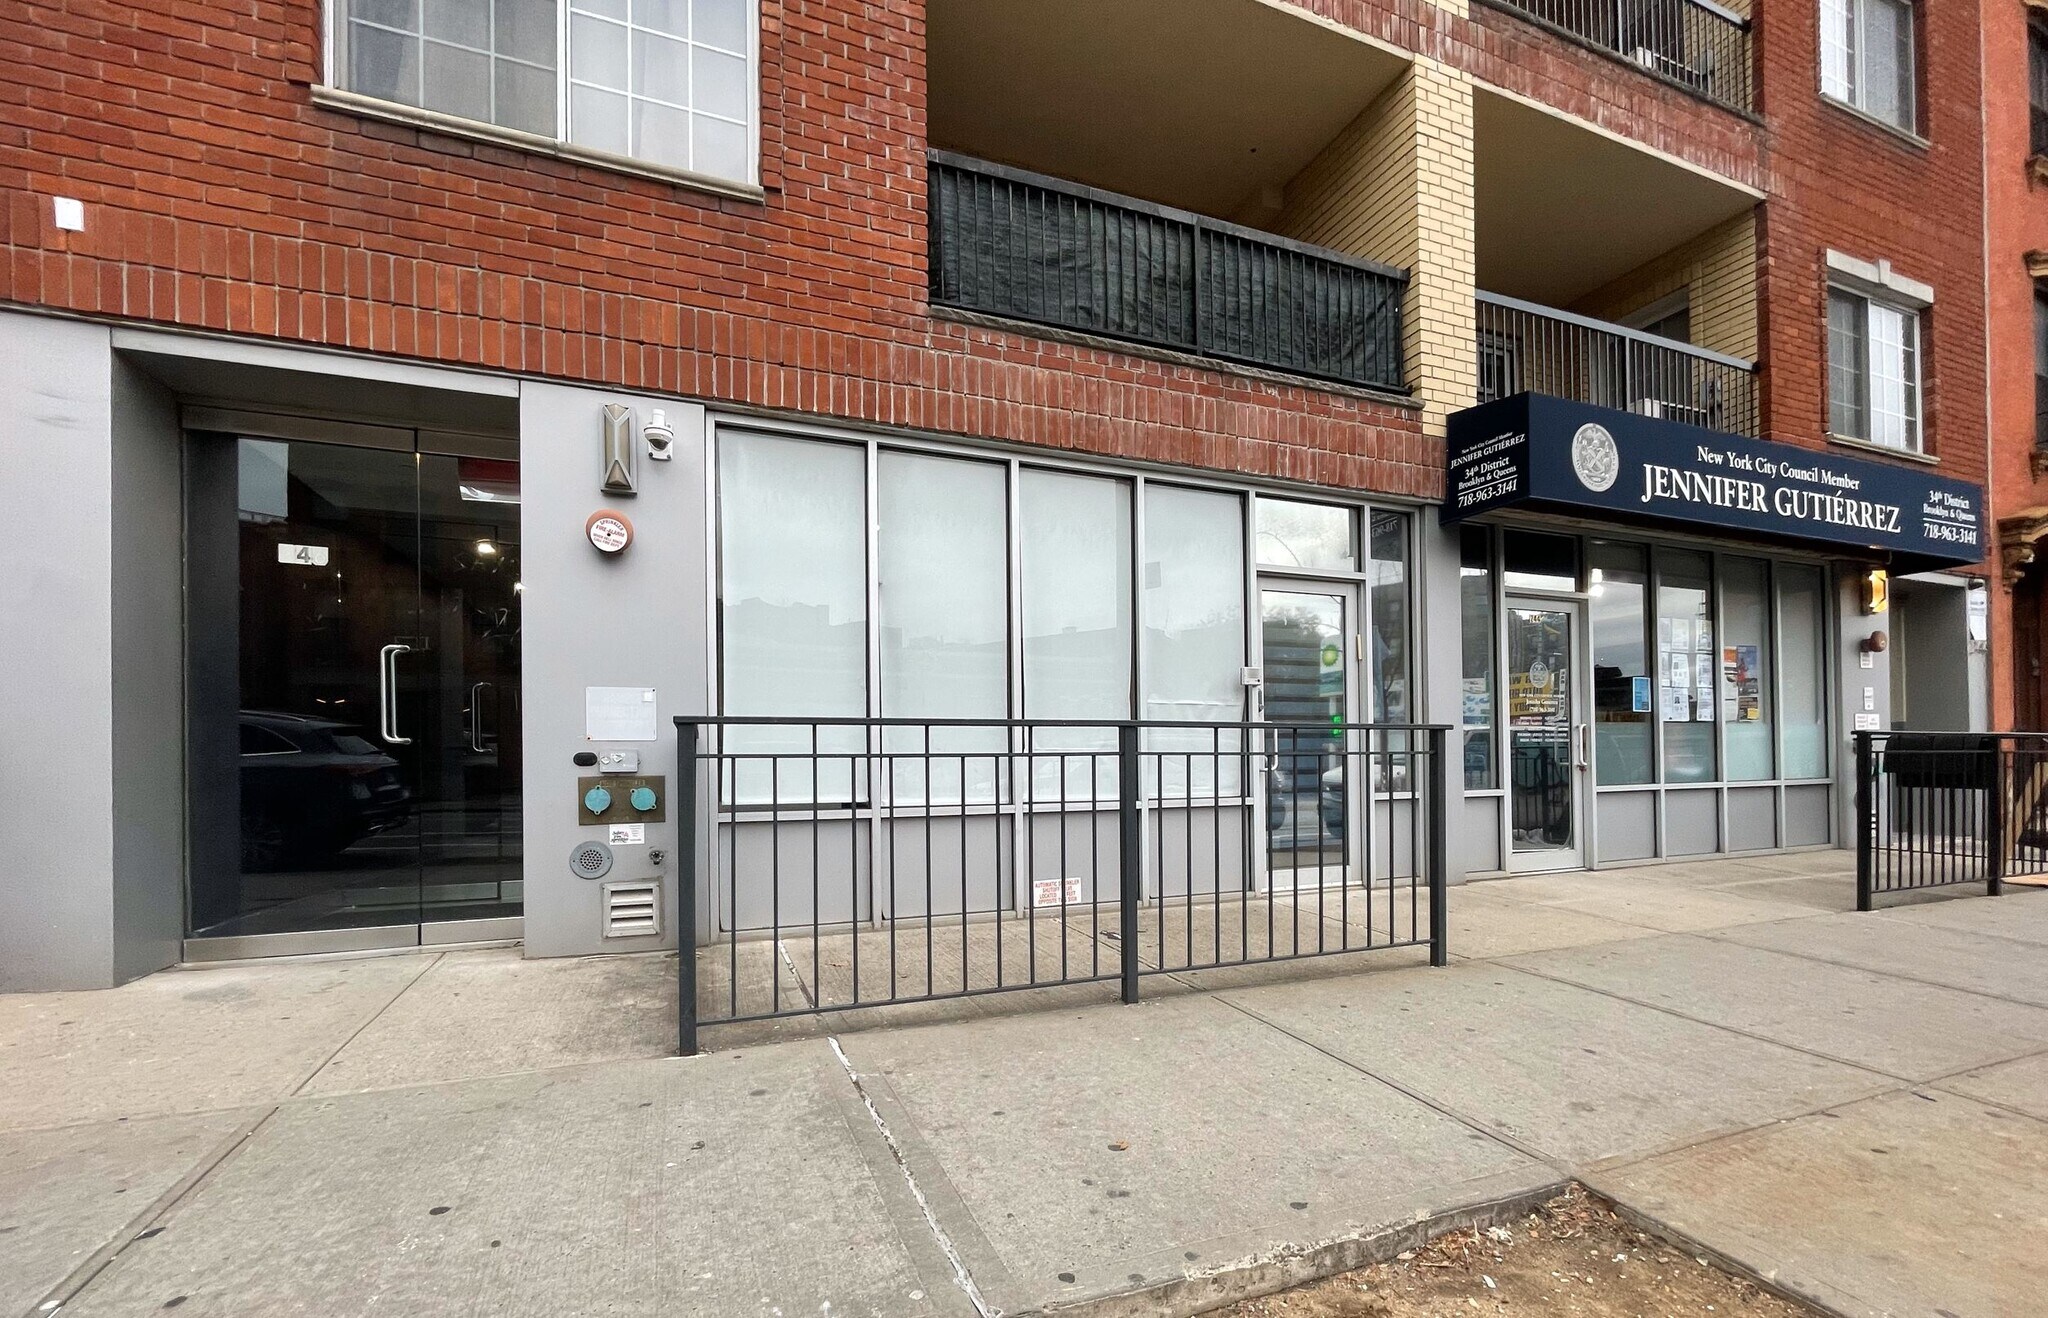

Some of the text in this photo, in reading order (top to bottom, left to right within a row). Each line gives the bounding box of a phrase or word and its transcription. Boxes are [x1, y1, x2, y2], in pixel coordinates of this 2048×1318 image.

[1450, 434, 1525, 469] JENNIFER GUTIÉRREZ
[1458, 465, 1516, 490] Brooklyn & Queens
[1480, 457, 1509, 474] District
[1697, 446, 1859, 490] New York City Council Member
[1458, 479, 1517, 508] 718-963-3141
[1641, 463, 1902, 534] JENNIFER GUTIÉRREZ
[1944, 493, 1969, 509] District
[1923, 523, 1977, 545] 718-963-3141
